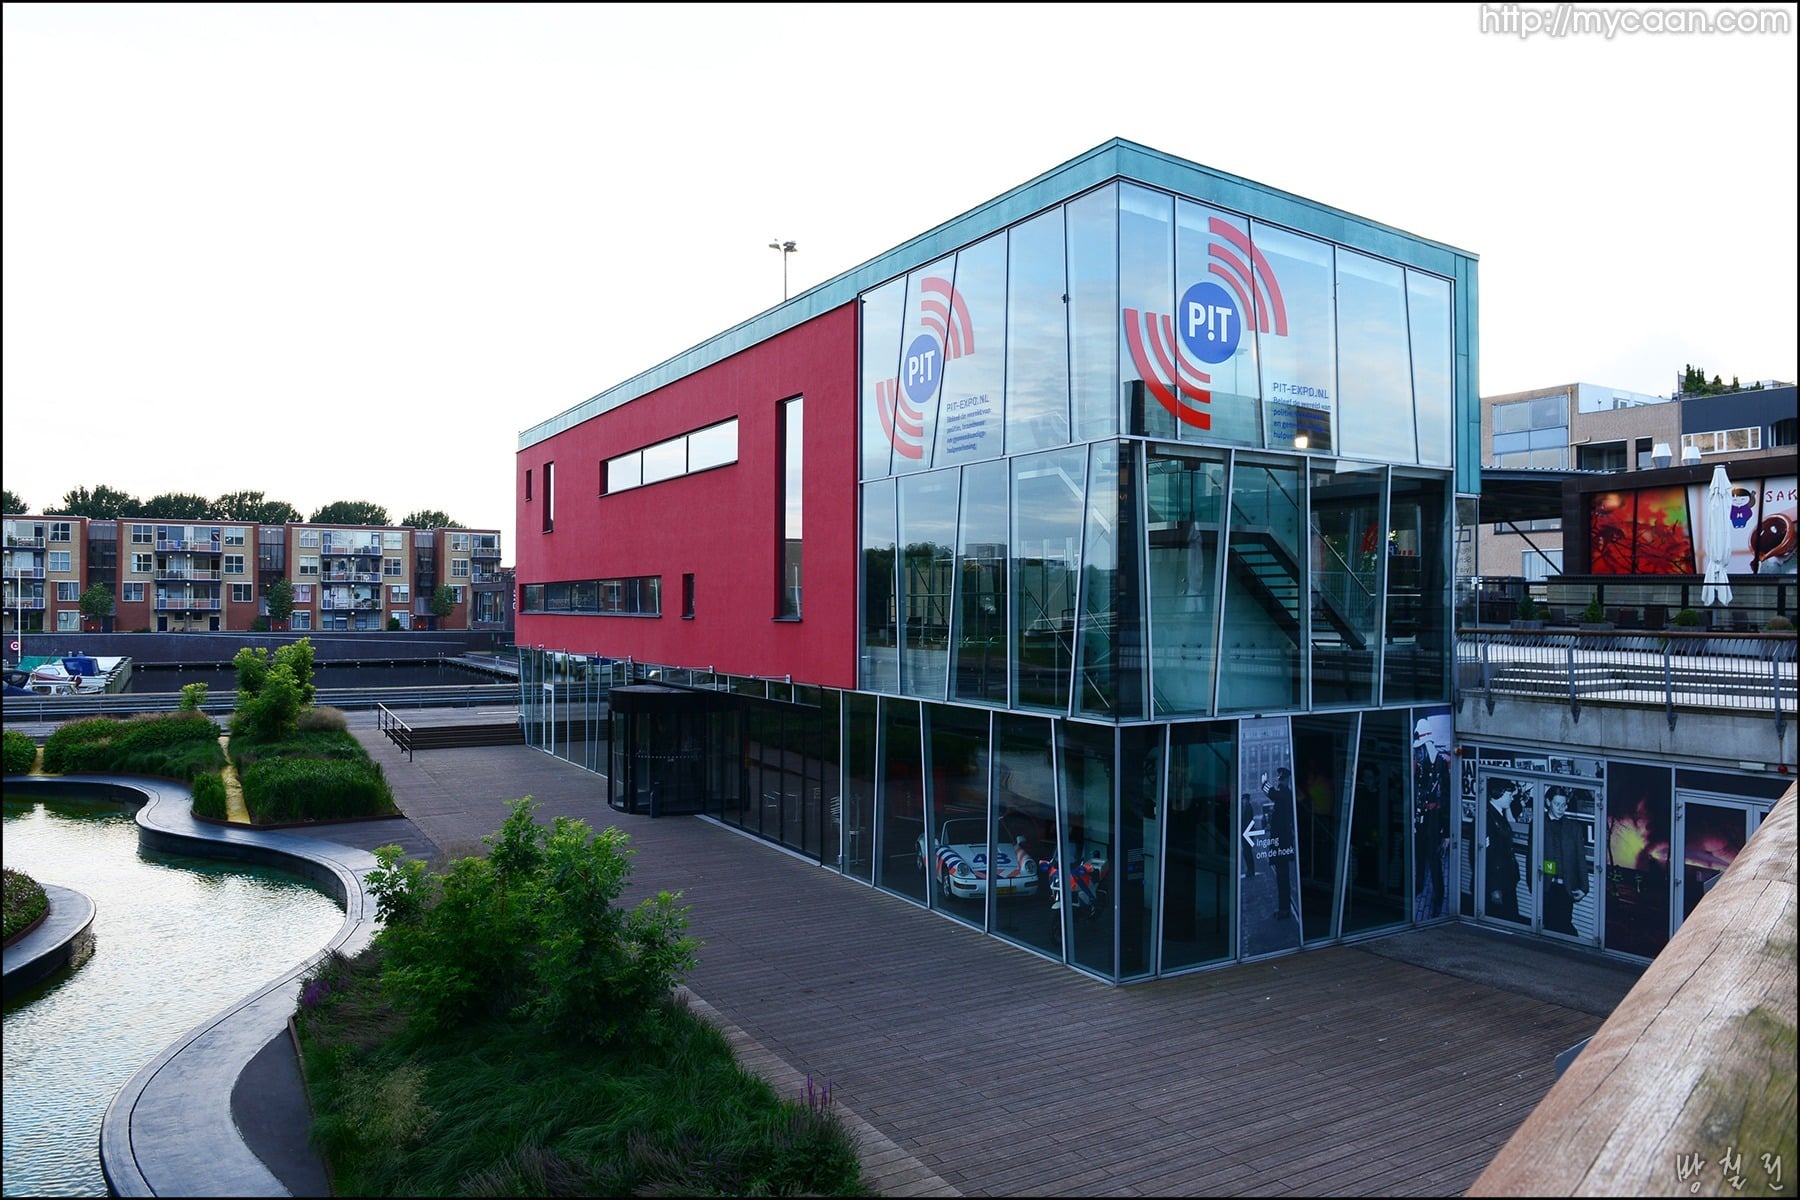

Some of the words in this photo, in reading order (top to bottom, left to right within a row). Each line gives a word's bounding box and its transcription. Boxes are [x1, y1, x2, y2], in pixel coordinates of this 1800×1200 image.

[1272, 382, 1329, 399] PIT-EXPO.NL
[1765, 488, 1797, 503] SAK
[1256, 837, 1279, 848] Ingang
[1256, 851, 1267, 859] om
[1268, 848, 1277, 857] de
[1278, 845, 1295, 855] hoek
